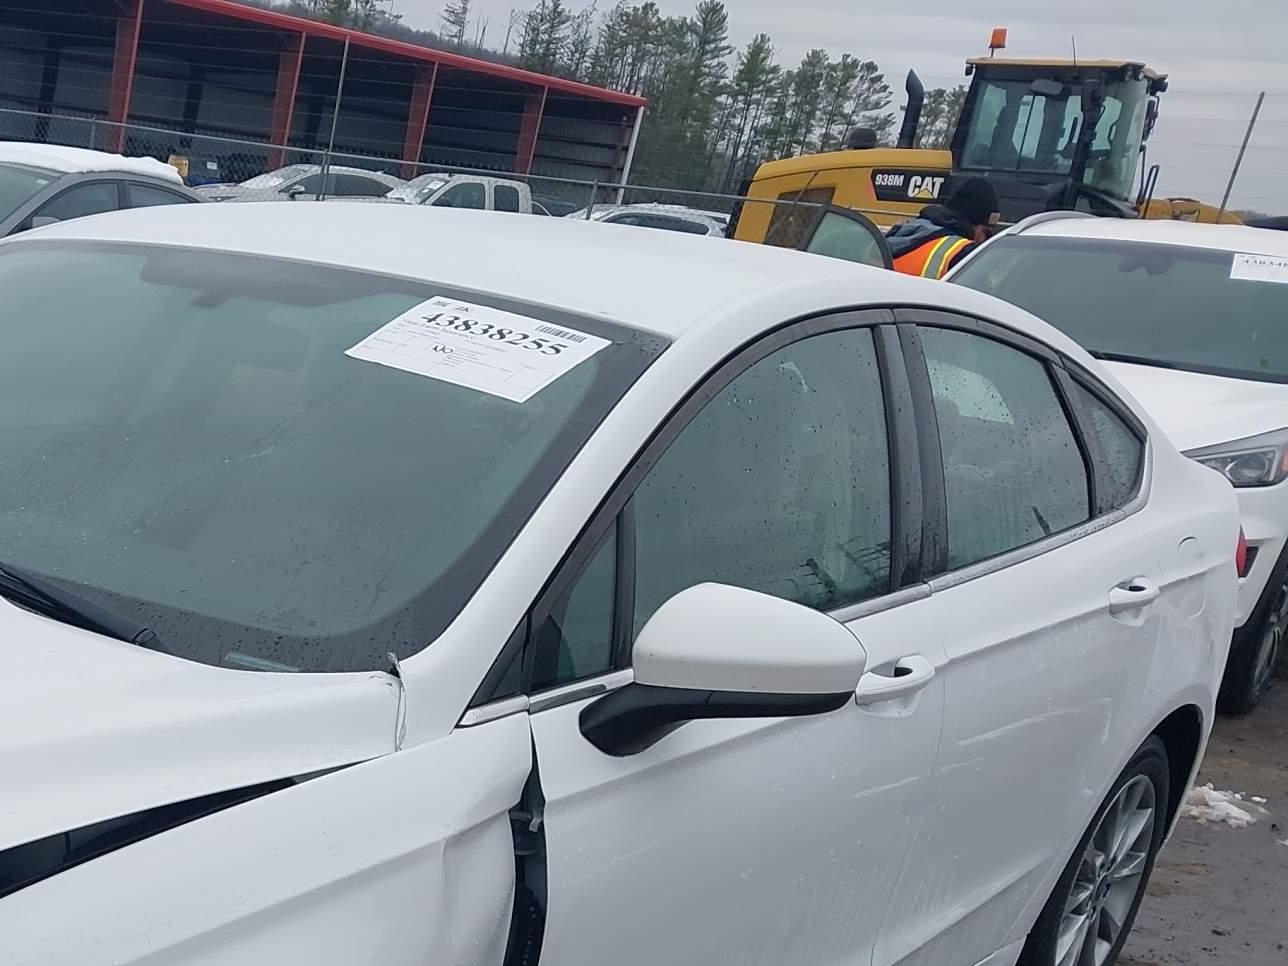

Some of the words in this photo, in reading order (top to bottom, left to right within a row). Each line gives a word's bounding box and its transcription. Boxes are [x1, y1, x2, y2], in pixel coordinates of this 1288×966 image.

[875, 173, 905, 187] 938M
[907, 175, 945, 199] CAT
[421, 312, 569, 356] 43838255
